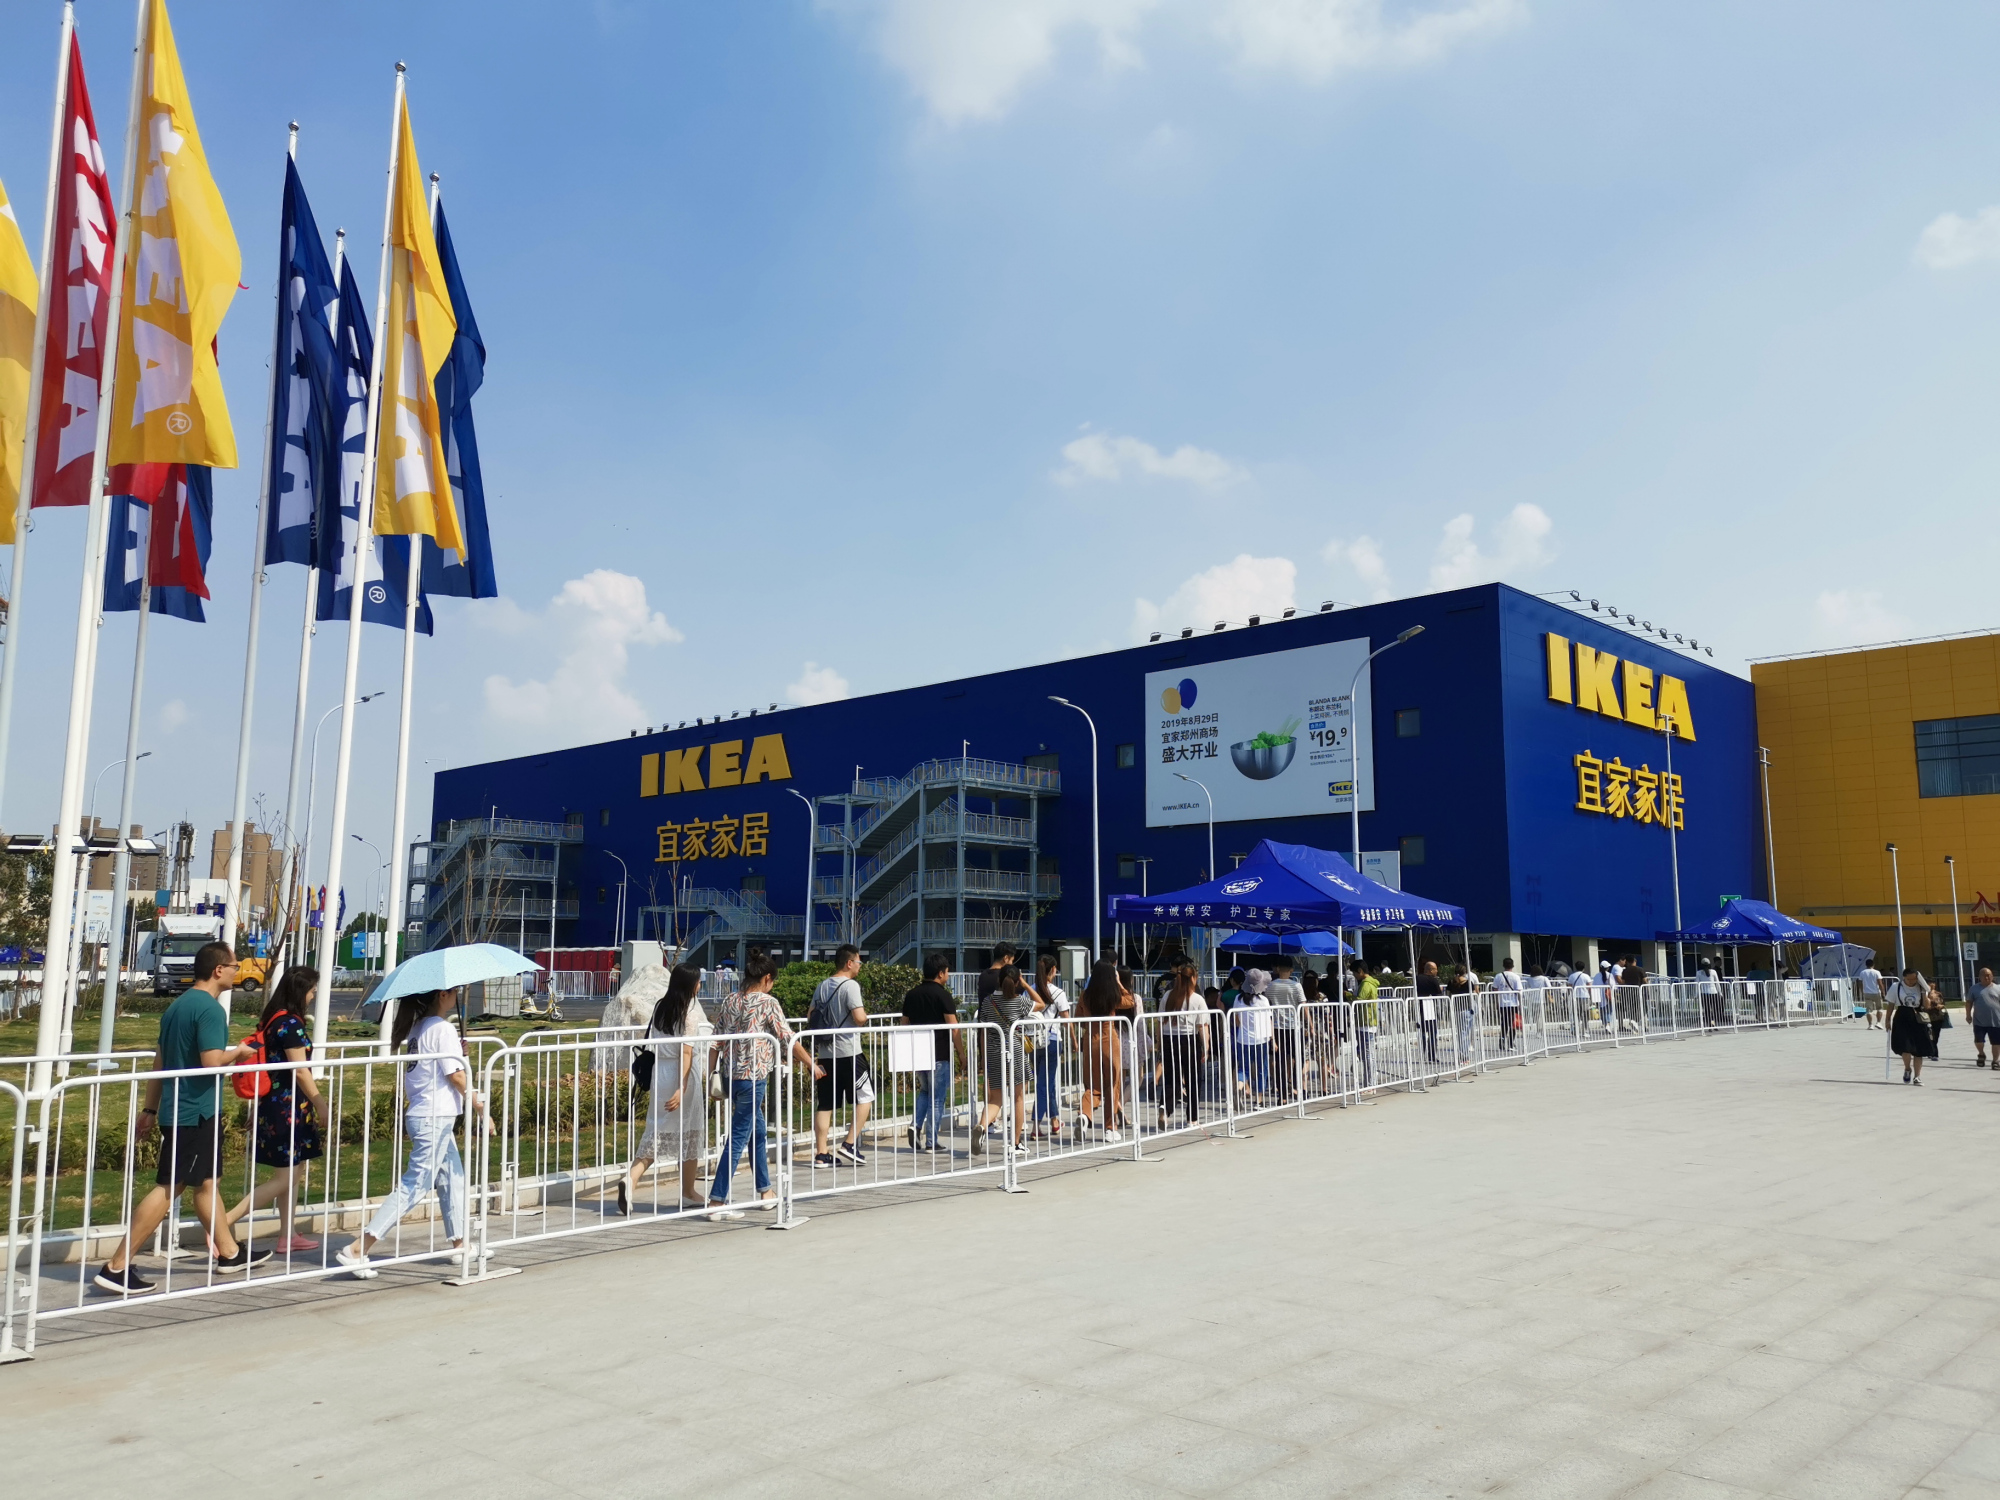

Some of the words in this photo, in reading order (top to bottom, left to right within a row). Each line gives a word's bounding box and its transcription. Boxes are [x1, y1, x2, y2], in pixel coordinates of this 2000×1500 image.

[1546, 632, 1697, 741] IKEA
[1161, 713, 1219, 729] 2019年8月29日
[1161, 726, 1219, 744] 宜家郑州商场
[1309, 727, 1348, 748] ¥19.9
[1162, 741, 1218, 763] 盛大开业
[640, 733, 793, 797] IKEA
[1574, 750, 1685, 830] 宜家家居
[1162, 802, 1200, 811] www.IKEA.cn
[655, 812, 770, 862] 宜家家居
[1971, 891, 2000, 912] 入
[1154, 904, 1211, 917] 华诚保安
[1230, 904, 1291, 921] 护卫专家
